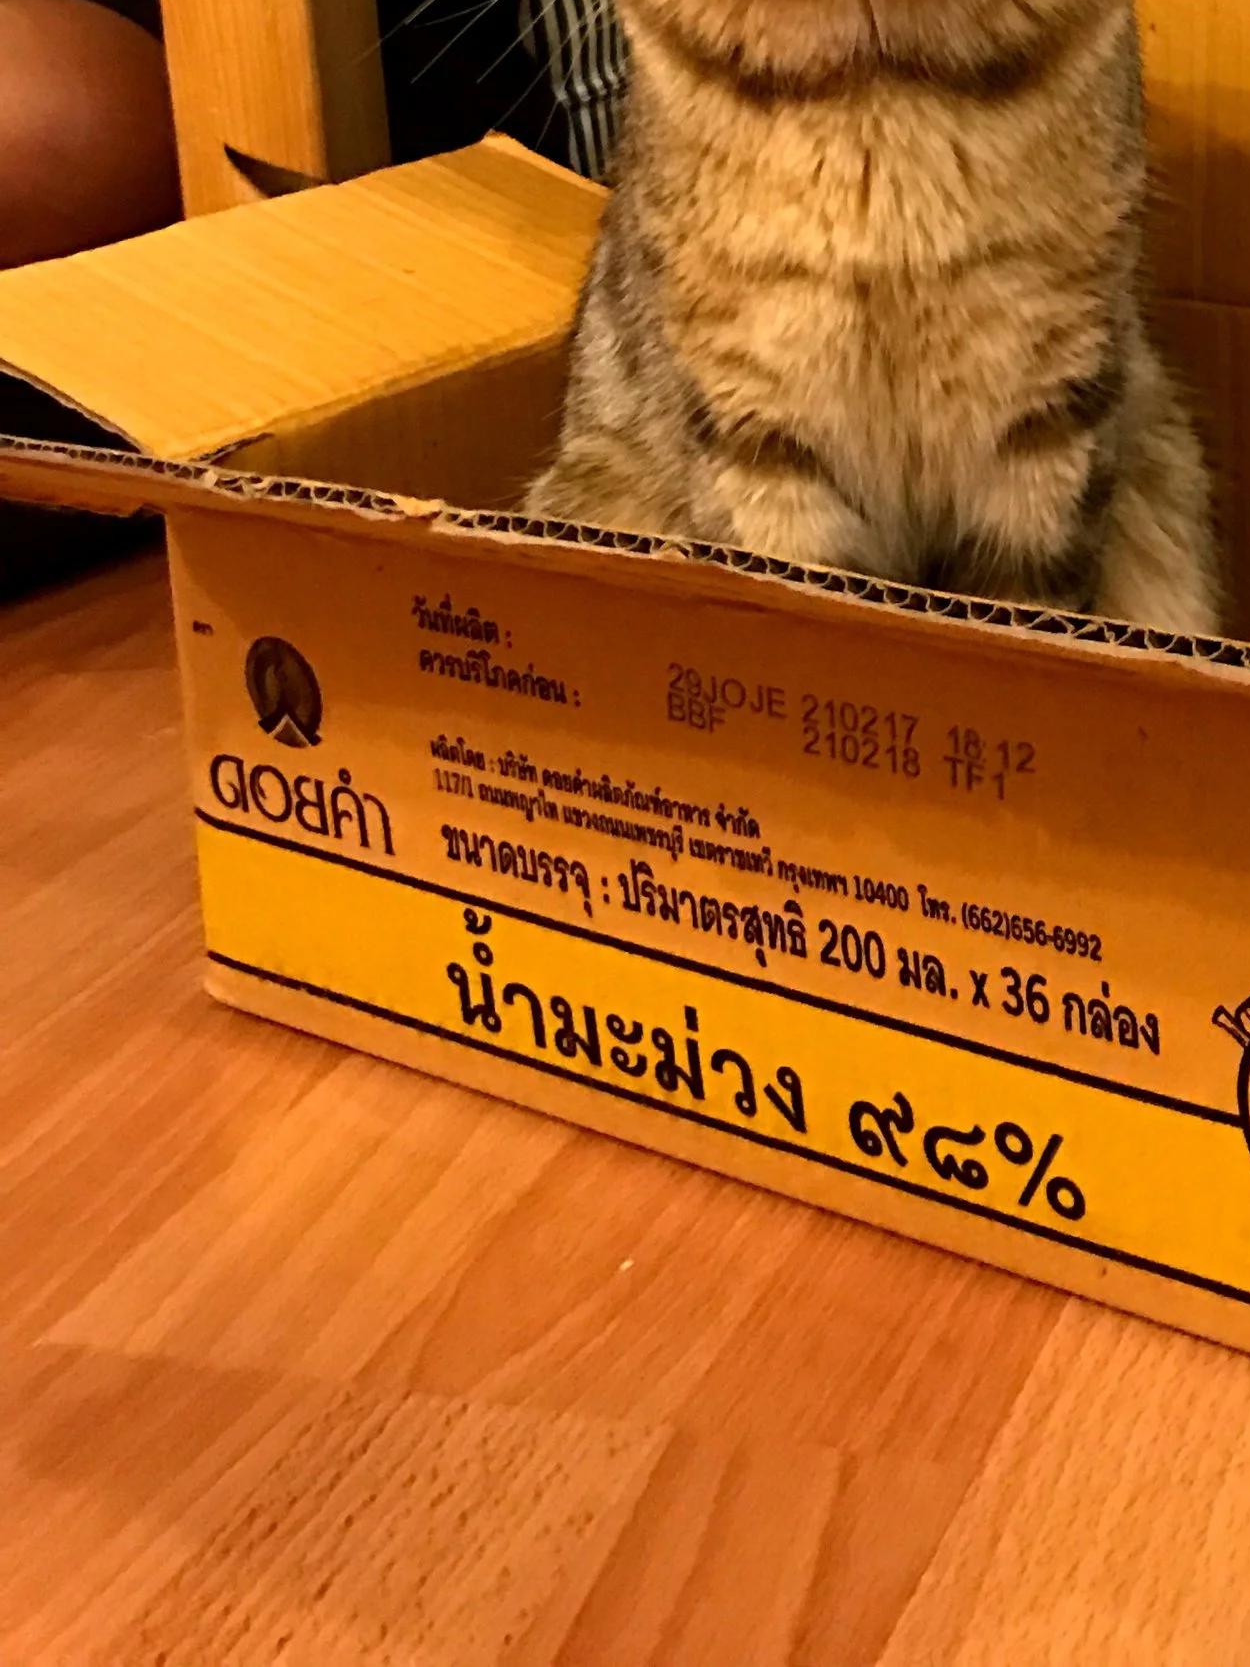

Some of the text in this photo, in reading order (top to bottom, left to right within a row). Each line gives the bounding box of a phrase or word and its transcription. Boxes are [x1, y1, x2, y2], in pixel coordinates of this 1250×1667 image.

[666, 692, 727, 733] BBF
[802, 725, 921, 779] 210218
[801, 694, 920, 746] 210217
[210, 753, 396, 856] ดอยคำ
[441, 824, 592, 918] ขนาดบรรจุ
[618, 858, 807, 967] ปริมาตรสุทธิ
[818, 919, 886, 979] 200
[897, 947, 958, 999] มล.
[1000, 966, 1050, 1024] 36
[1062, 980, 1160, 1055] กล่อง
[853, 875, 908, 911] 10400
[961, 902, 1102, 962] (662)656-6992
[447, 908, 807, 1135] น้ำมะม่วง
